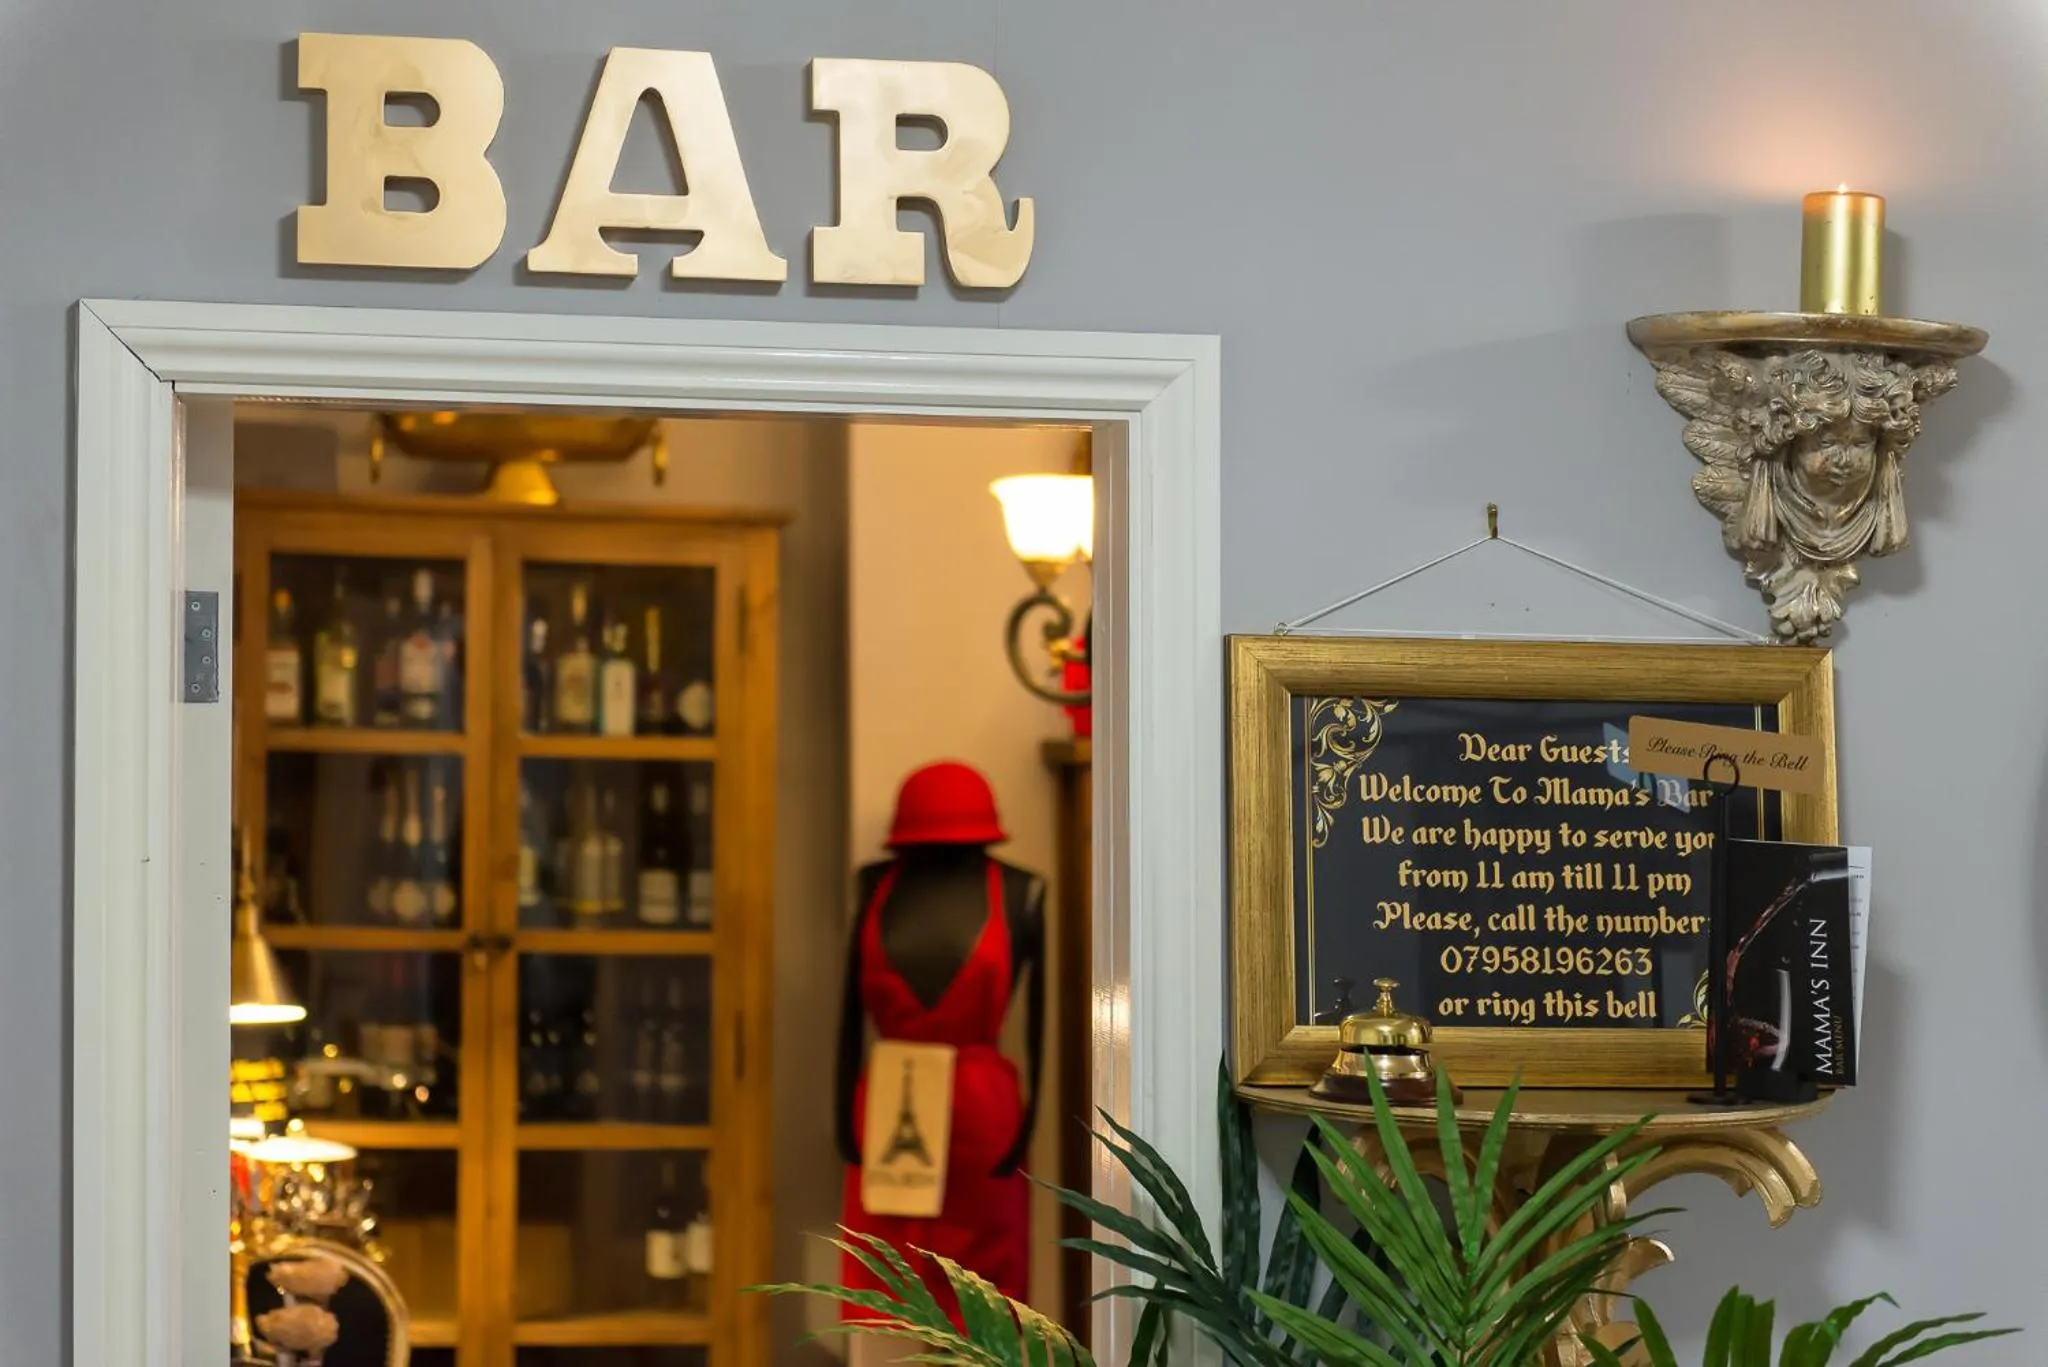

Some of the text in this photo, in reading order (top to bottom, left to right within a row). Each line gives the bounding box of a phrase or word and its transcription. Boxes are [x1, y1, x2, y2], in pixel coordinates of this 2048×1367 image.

[298, 32, 1034, 287] BAR
[1458, 732, 1533, 762] Dear
[1646, 735, 1810, 772] Please Ring the Bell
[1359, 772, 1714, 810] Welcome To Mama's Bar
[1361, 814, 1405, 845] We
[1412, 826, 1457, 846] are
[1463, 818, 1551, 855] happy
[1558, 822, 1587, 848] to
[1594, 826, 1668, 849] serve
[1398, 859, 1692, 899] from 11 am till 11 pm
[1372, 901, 1480, 938] Please,
[1487, 903, 1536, 932] call
[1543, 904, 1589, 937] the
[1440, 945, 1653, 976] 07958196263
[1438, 989, 1657, 1025] or ring this bell
[1809, 918, 1833, 1075] MAMA'S INN
